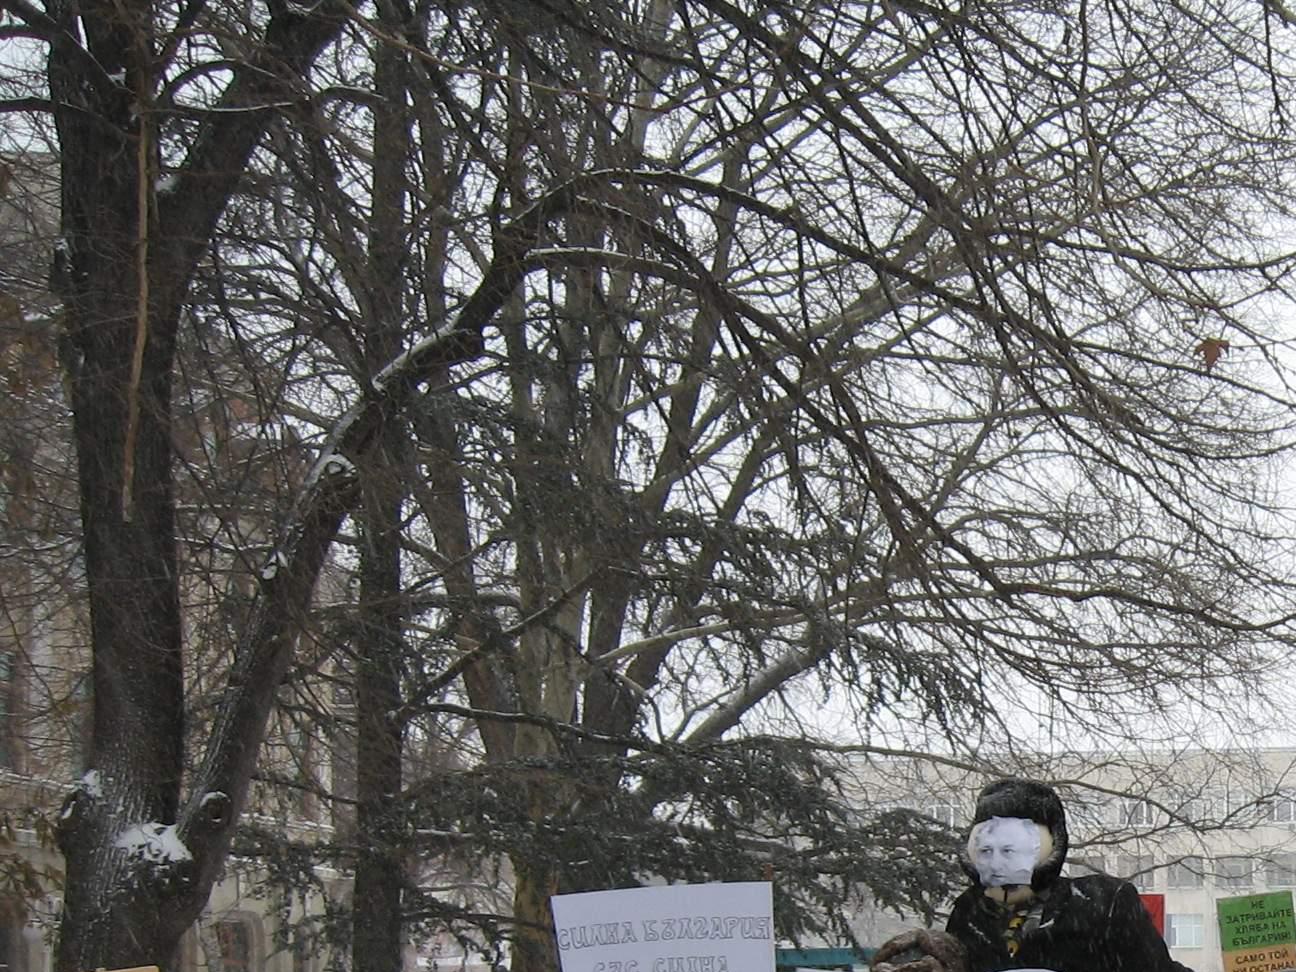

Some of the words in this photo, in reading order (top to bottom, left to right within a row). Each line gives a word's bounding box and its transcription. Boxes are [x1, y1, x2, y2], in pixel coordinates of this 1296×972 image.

[1251, 900, 1264, 909] НЕ
[1272, 920, 1287, 930] НА
[557, 920, 638, 950] СИЛНА
[642, 916, 771, 942] БЪЛГАРИЯ
[1235, 953, 1266, 965] САМО
[1268, 948, 1289, 960] ТОЙ
